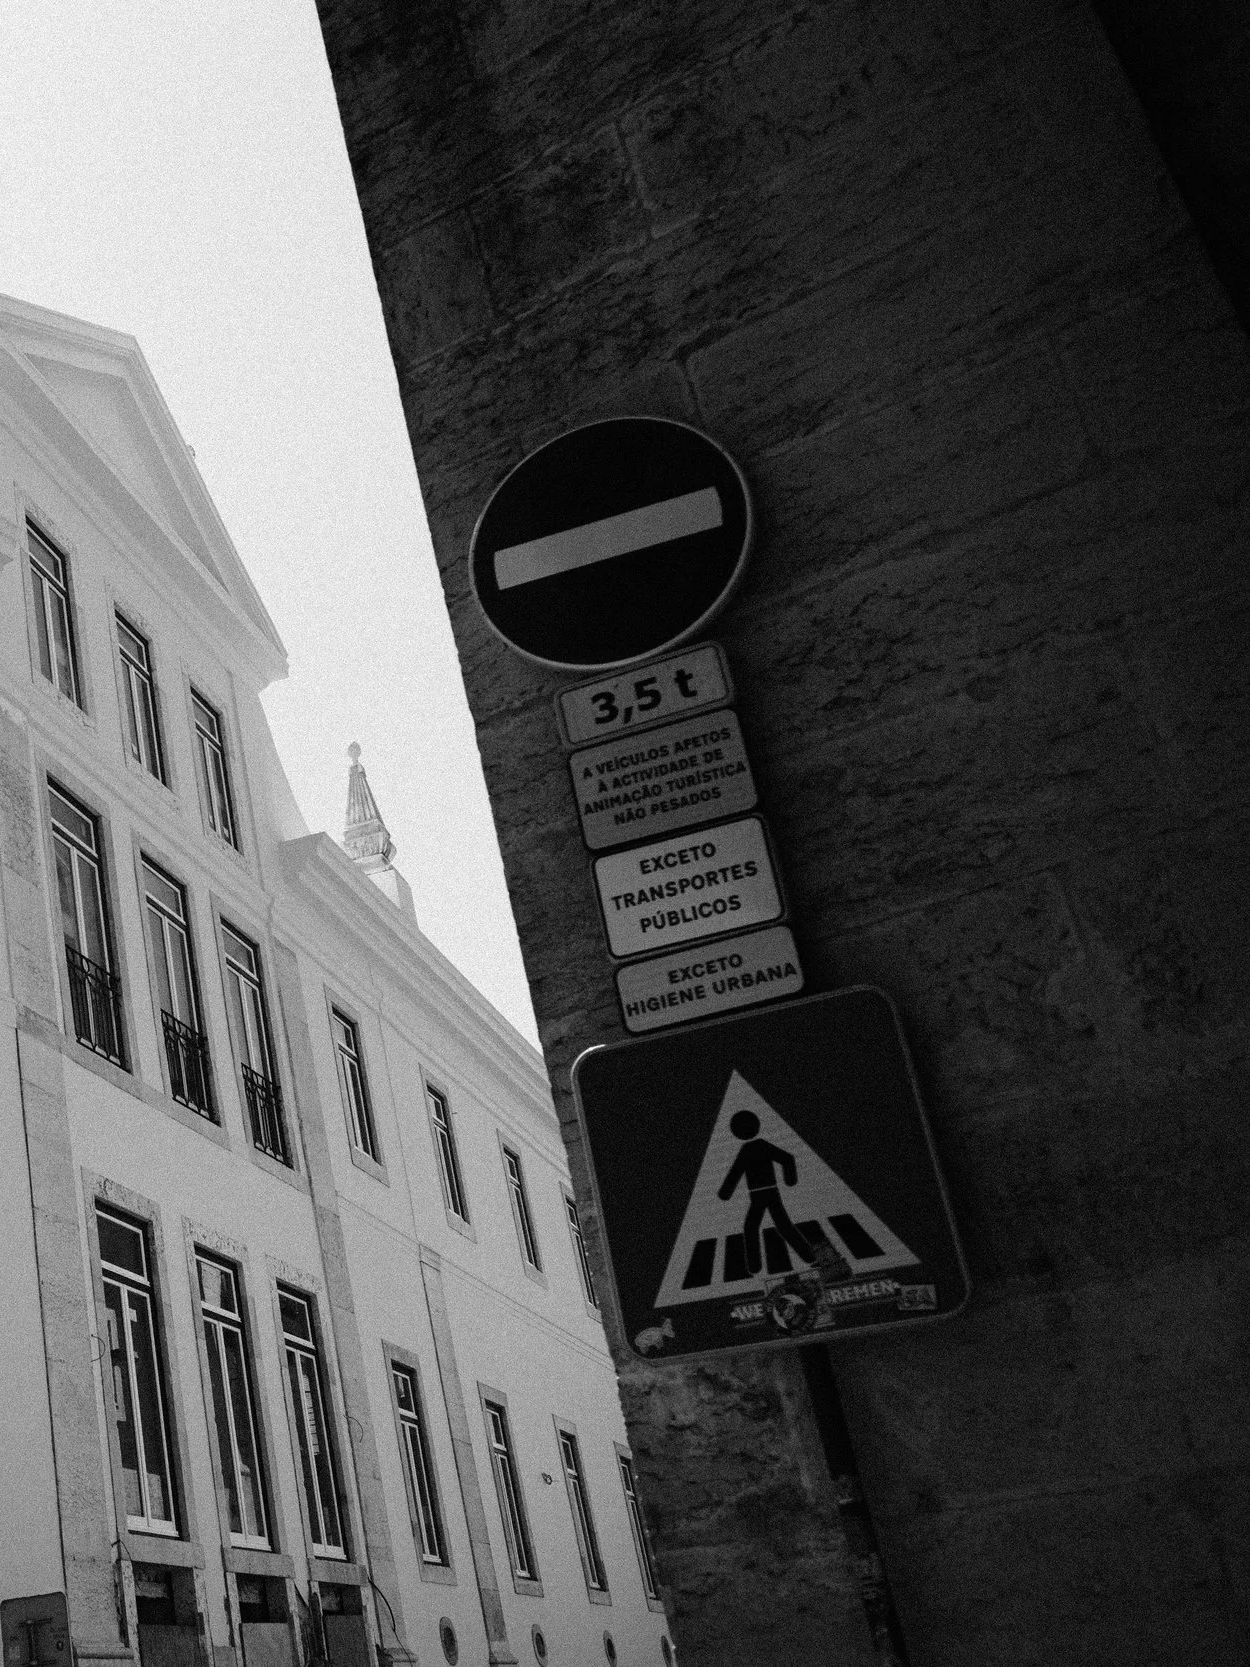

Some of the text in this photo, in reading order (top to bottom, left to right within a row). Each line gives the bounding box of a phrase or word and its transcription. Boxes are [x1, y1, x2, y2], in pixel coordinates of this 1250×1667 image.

[591, 668, 698, 724] 3,5 t
[582, 728, 731, 779] A VEÍCULOS AFETOS
[612, 755, 698, 788] ACTIVIDADE
[703, 749, 725, 763] DE
[583, 760, 747, 815] ANIMAÇÃO TURÍSTICA
[613, 787, 722, 825] NÃO PESADOS
[639, 842, 716, 875] EXCETO
[611, 860, 758, 911] TRANSPORTES
[640, 894, 742, 933] PÚBLICOS
[625, 962, 797, 1017] HIGIENE URBANA
[668, 953, 743, 984] EXCETO
